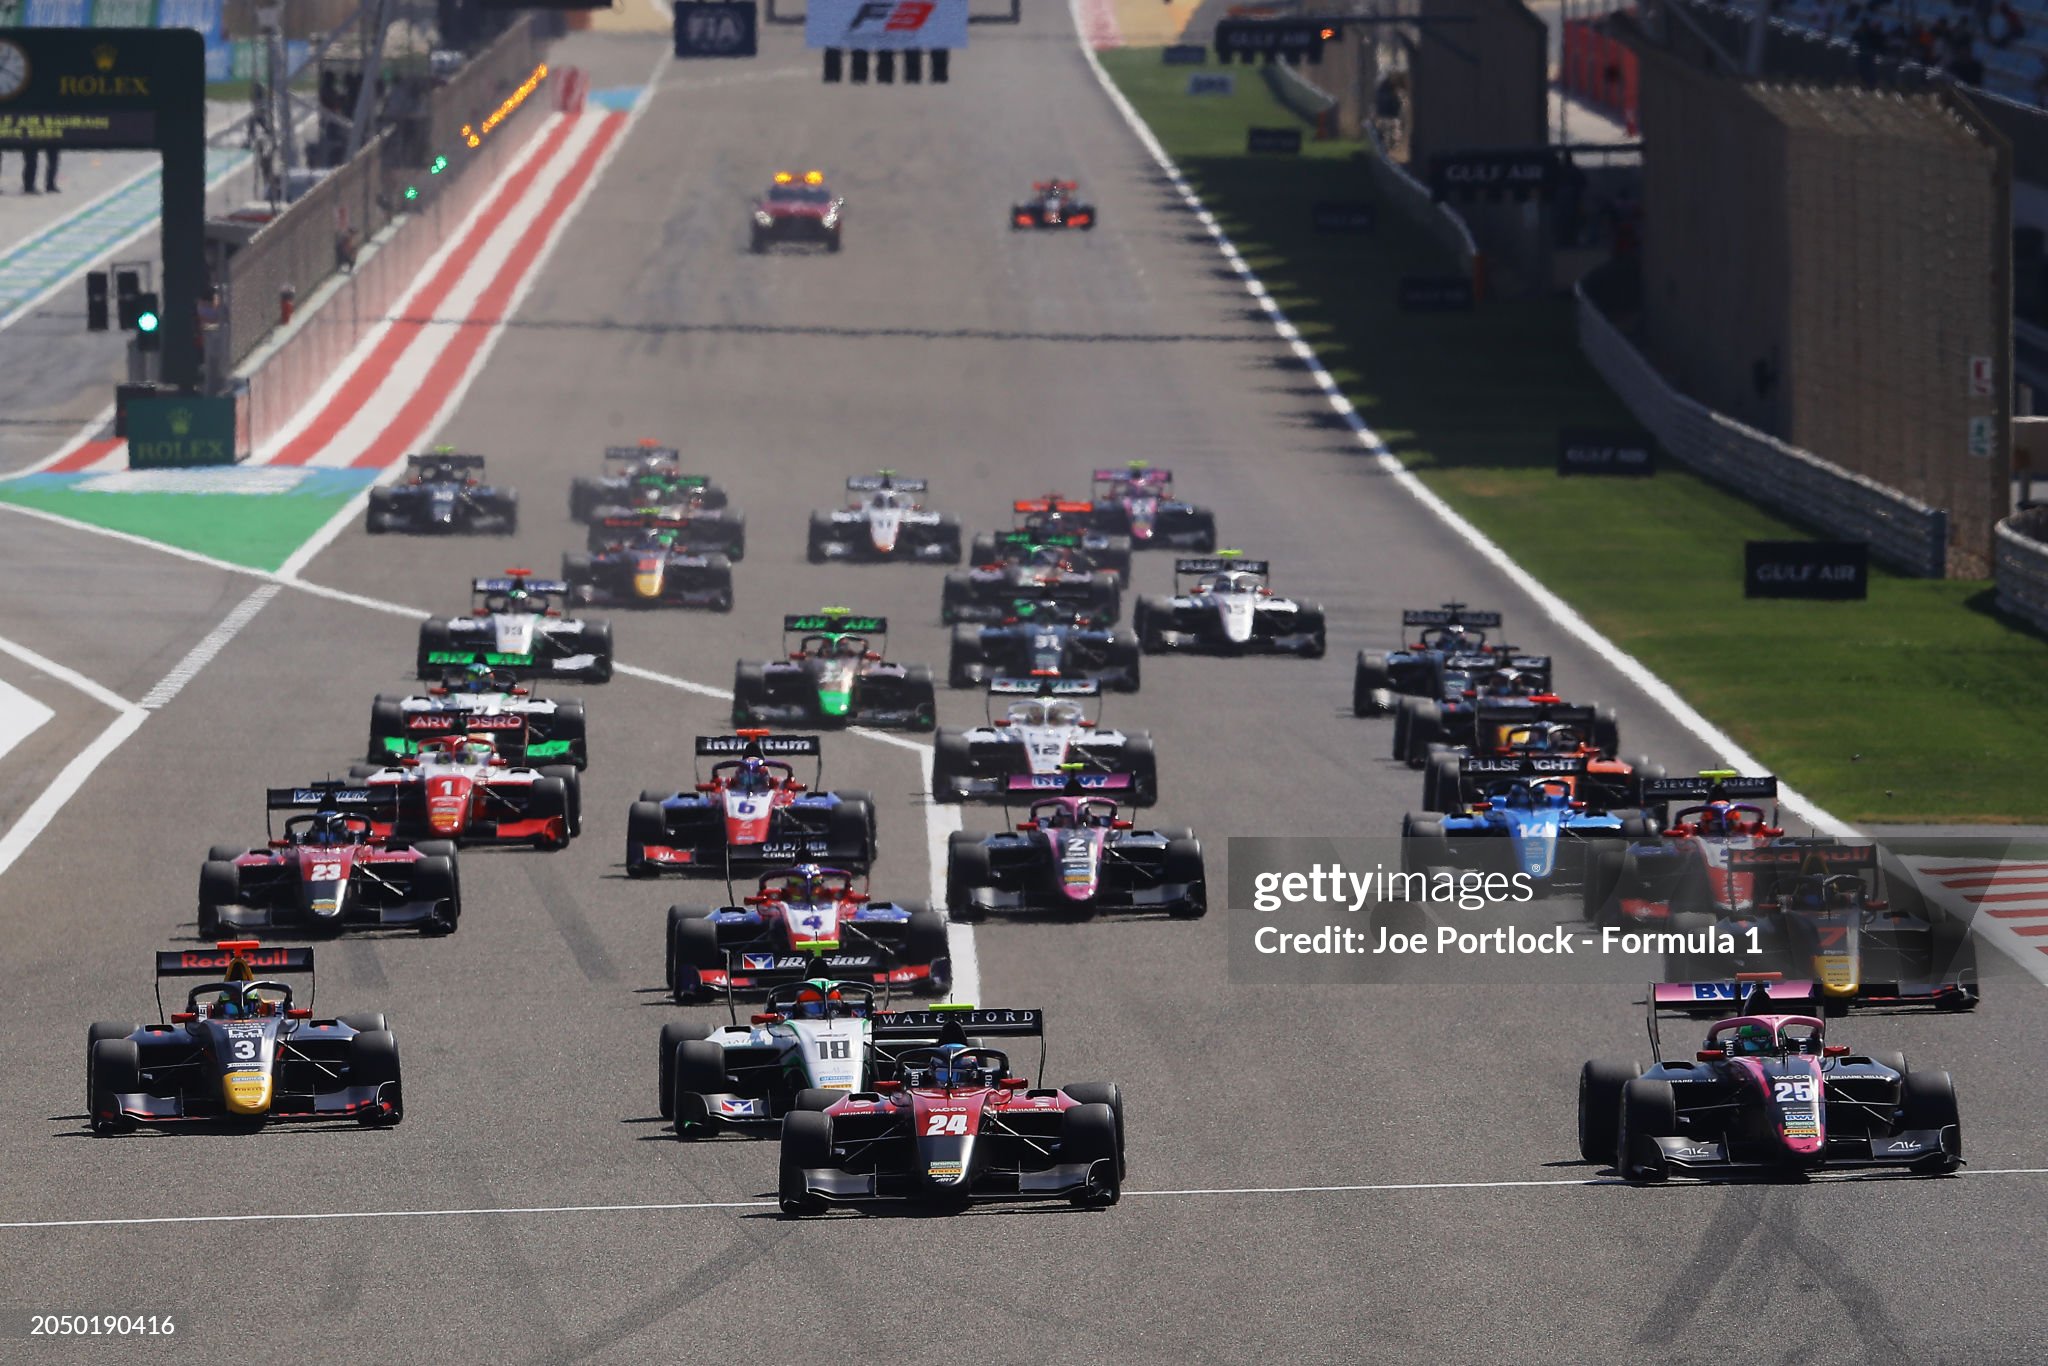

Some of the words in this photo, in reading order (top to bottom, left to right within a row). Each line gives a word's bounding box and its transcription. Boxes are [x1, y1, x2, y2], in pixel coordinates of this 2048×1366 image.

[850, 2, 935, 31] F3
[687, 14, 737, 42] FIA
[59, 75, 148, 95] ROLEX
[1446, 164, 1500, 182] GULF
[1508, 164, 1543, 180] AIR
[137, 441, 223, 459] ROLEX
[1756, 564, 1816, 580] GULF
[1818, 564, 1856, 580] AIR
[1467, 759, 1577, 772] PULSEIGHT
[441, 780, 453, 796] 1
[737, 801, 755, 814] 6
[1731, 850, 1801, 863] Red
[310, 864, 342, 881] 23
[802, 914, 823, 930] 4
[1816, 927, 1847, 948] 7
[181, 953, 231, 968] Red
[246, 951, 288, 965] Bull
[882, 1012, 1034, 1024] WATEFORD
[234, 1040, 256, 1060] 3
[815, 1040, 850, 1060] 18
[1774, 1082, 1814, 1102] 25
[926, 1114, 968, 1136] 24
